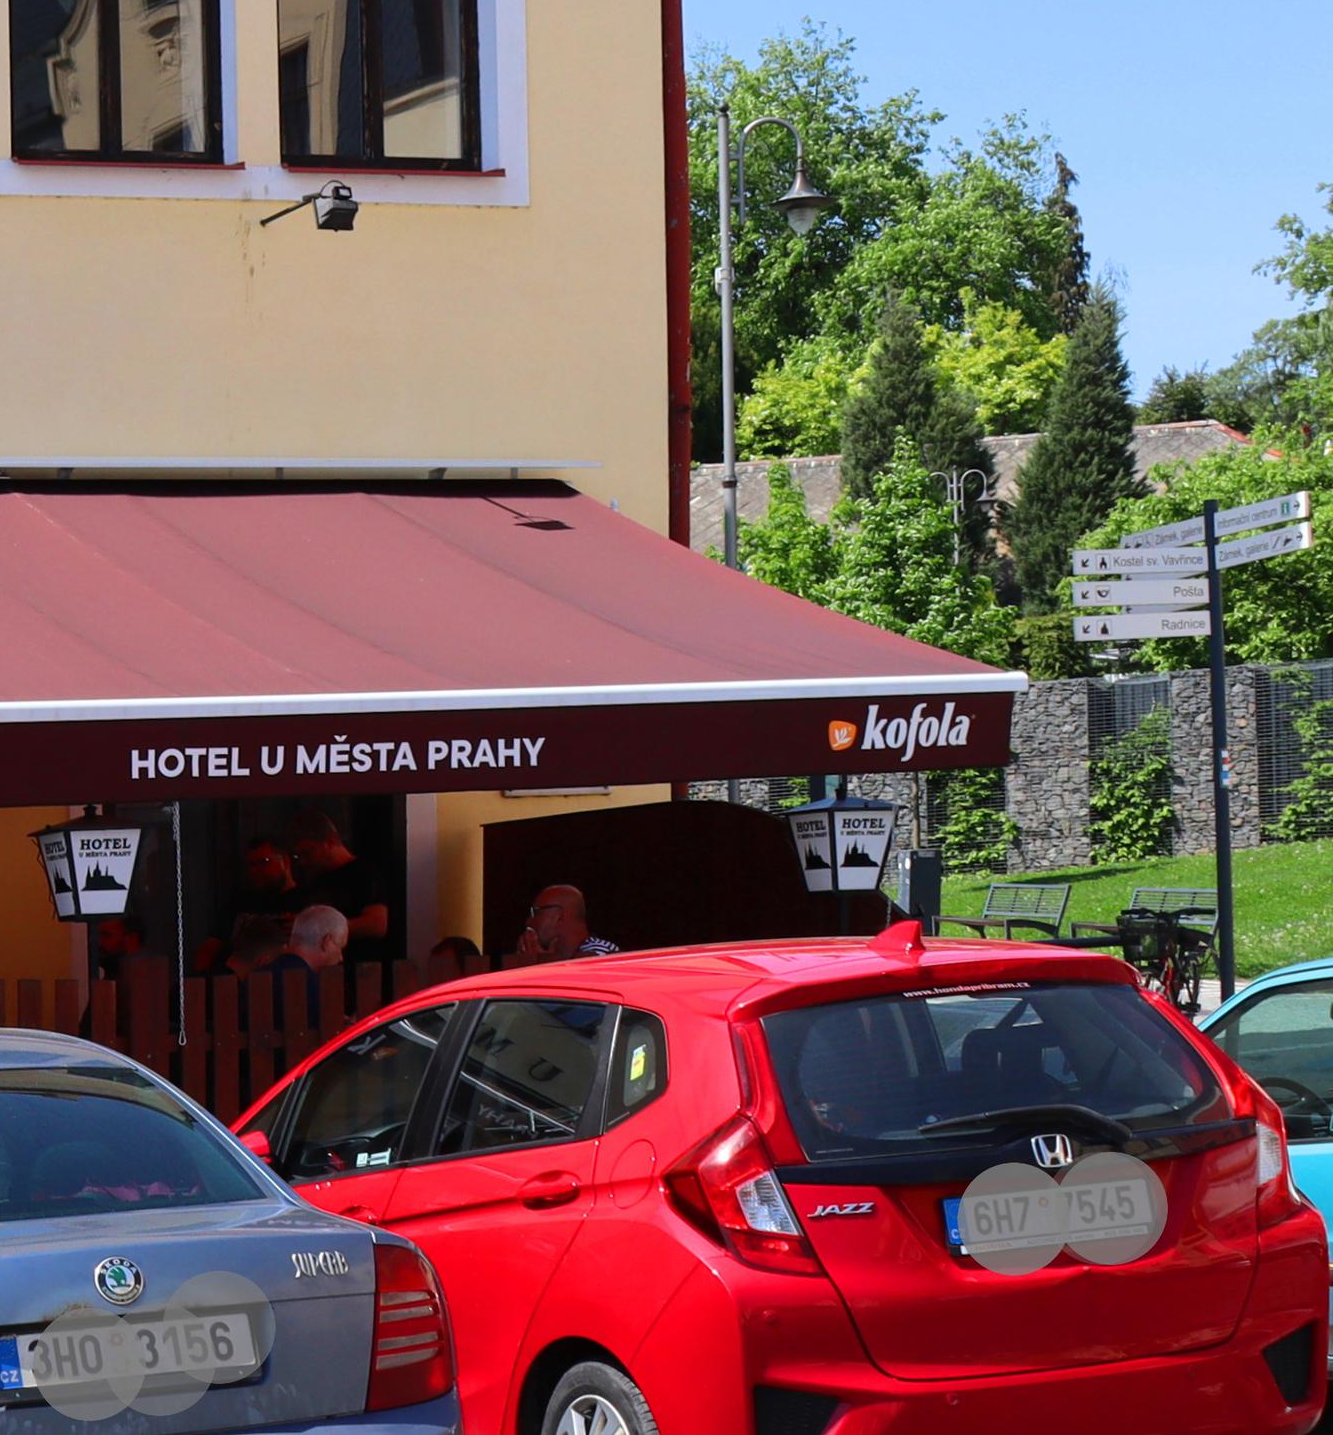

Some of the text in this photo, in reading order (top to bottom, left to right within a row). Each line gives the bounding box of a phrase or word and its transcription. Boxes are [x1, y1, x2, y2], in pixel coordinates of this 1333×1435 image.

[1113, 554, 1144, 567] Kostel
[1161, 554, 1204, 566] Vavřince
[1173, 586, 1205, 598] Pošta
[1161, 619, 1206, 631] Radnice
[860, 701, 971, 763] kofola
[130, 735, 546, 780] HOTEL U MĚSTA PRAHY
[796, 820, 826, 833] HOTEL
[842, 818, 887, 829] HOTEL
[80, 837, 132, 851] HOTEL
[806, 1201, 876, 1219] JAZZ
[973, 1196, 1031, 1236] 6H7
[291, 1250, 349, 1278] SUPERB
[136, 1321, 234, 1368] 3156
[0, 1370, 20, 1384] CZ
